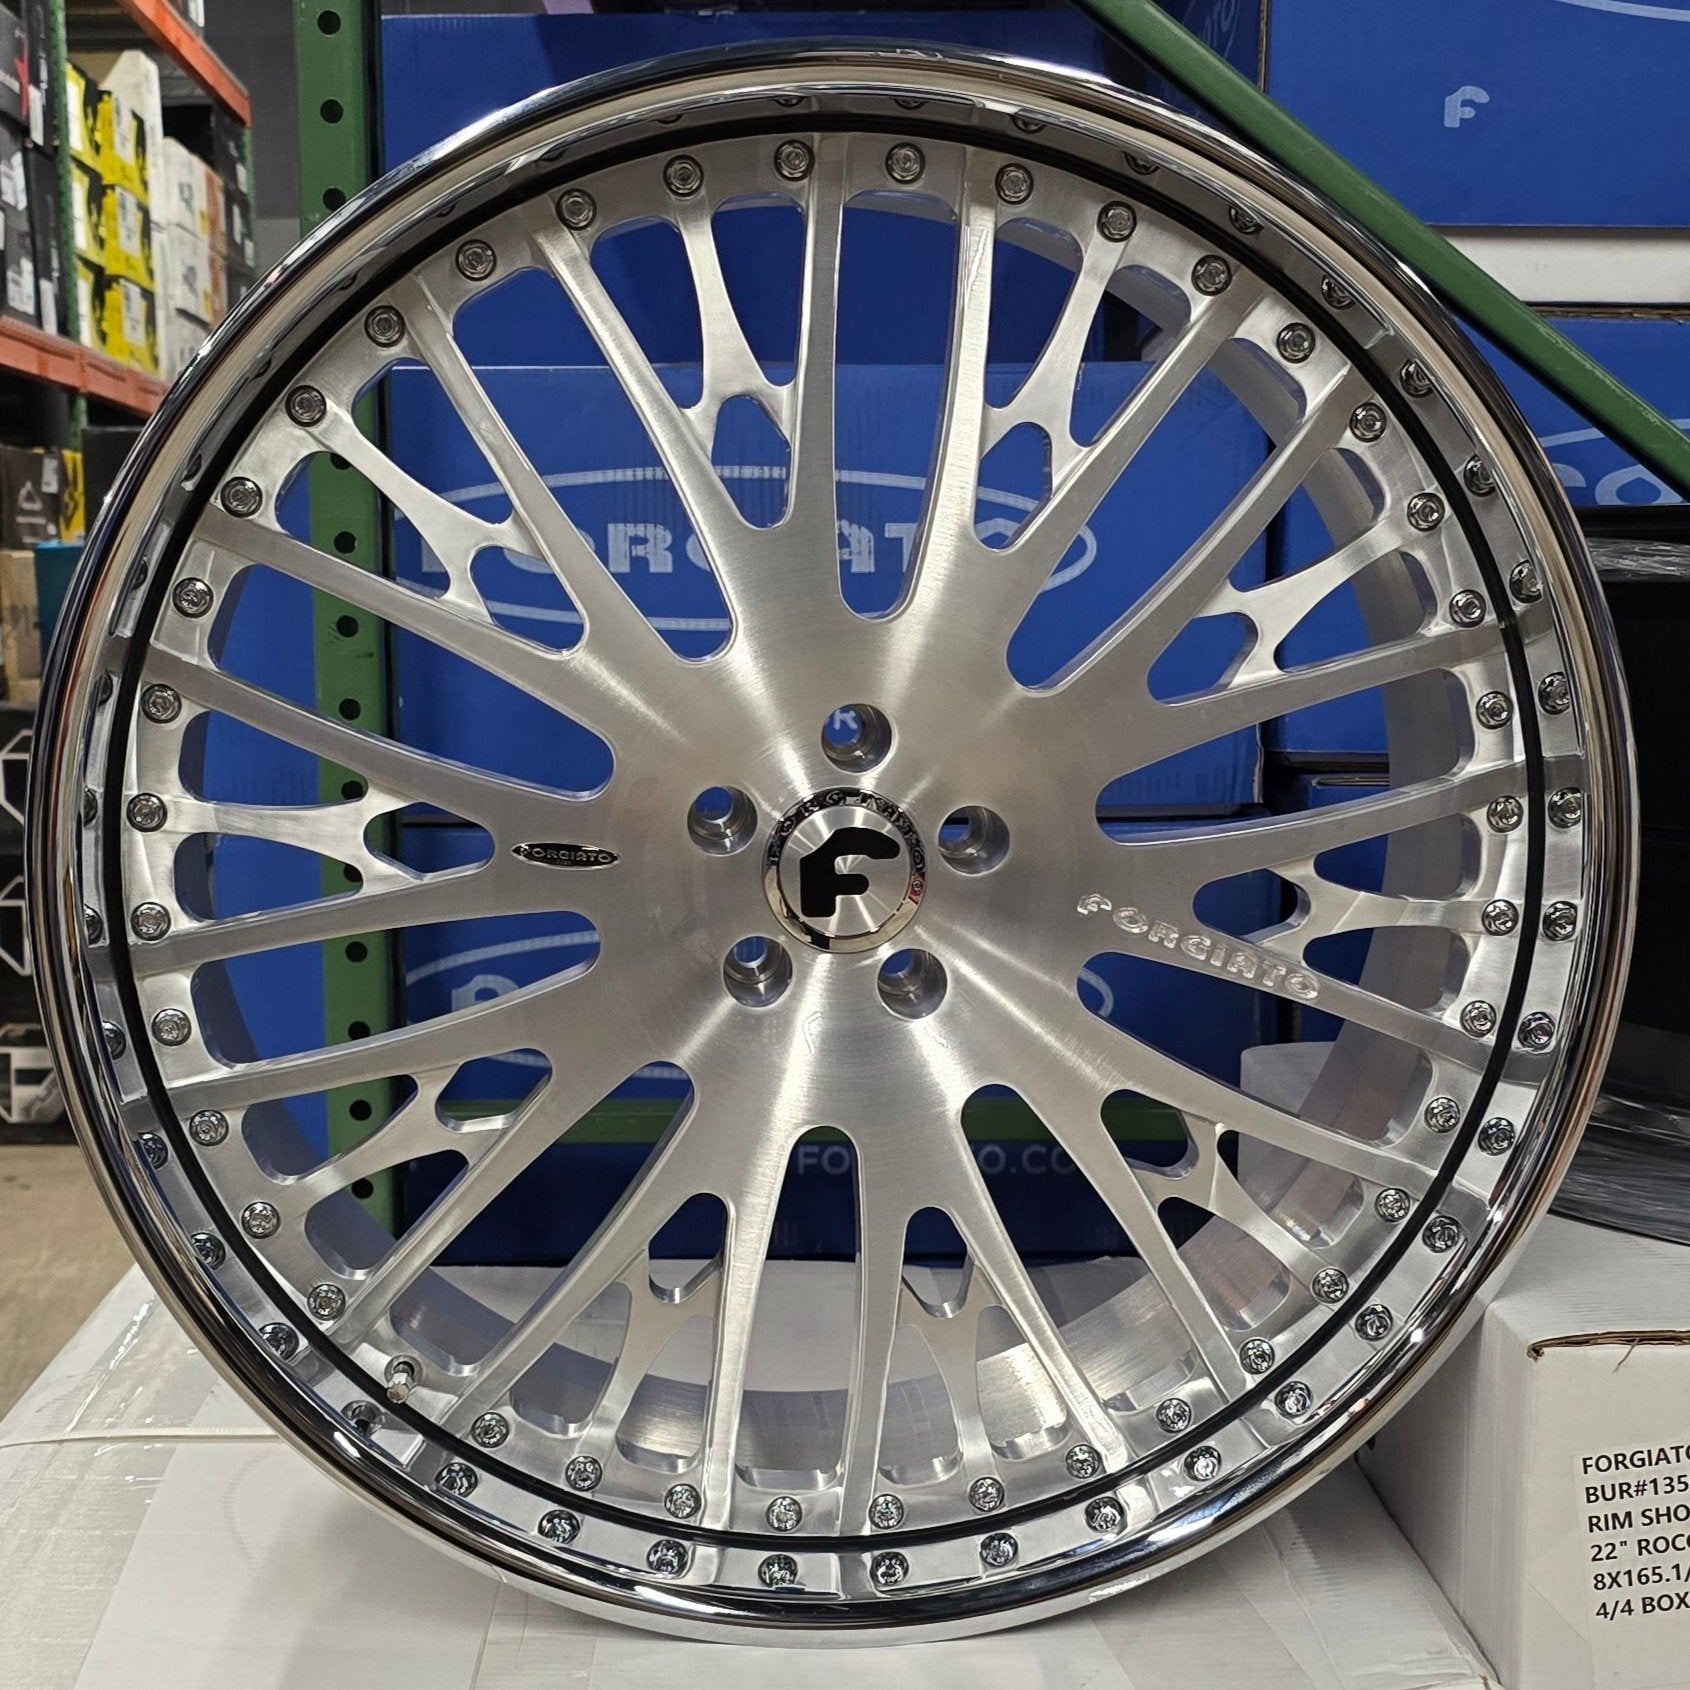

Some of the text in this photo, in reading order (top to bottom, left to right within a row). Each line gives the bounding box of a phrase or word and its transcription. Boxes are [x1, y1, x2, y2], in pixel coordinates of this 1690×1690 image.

[1077, 893, 1321, 1000] FORGIATO
[1582, 1443, 1690, 1475] FORGIAT
[1585, 1474, 1689, 1504] BUR#135
[1588, 1504, 1690, 1533] RIM SHO
[1590, 1533, 1690, 1562] 22" ROC
[1595, 1591, 1690, 1621] 4/4 BOX
